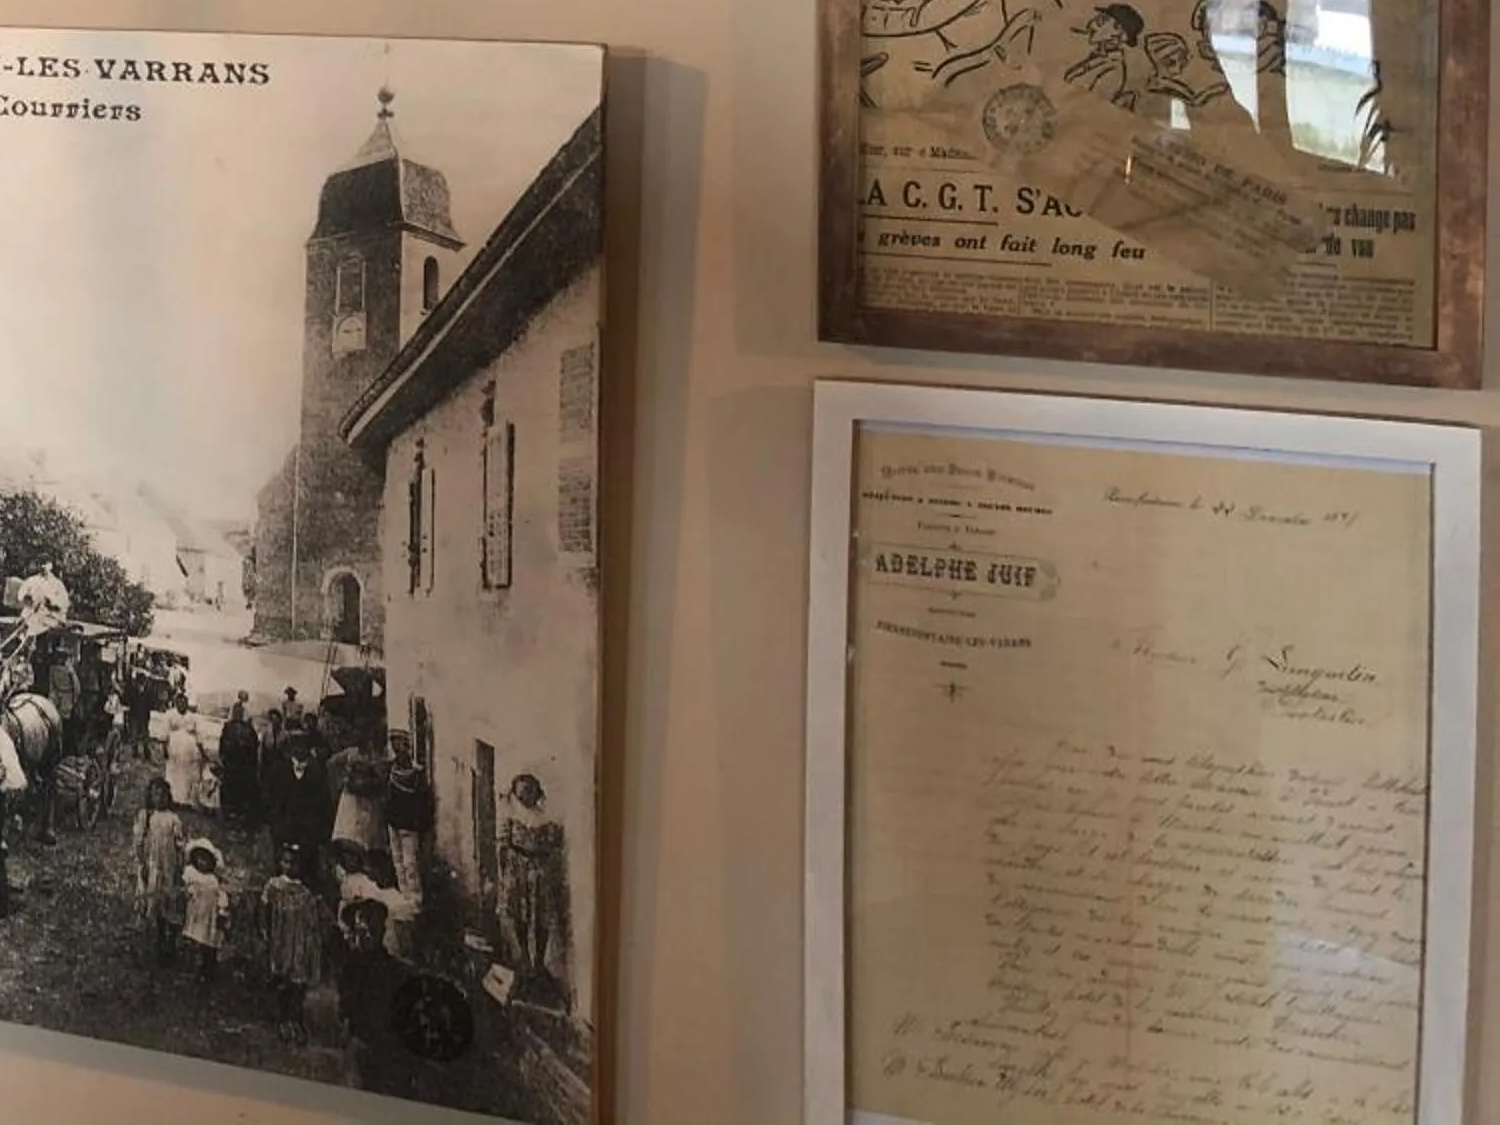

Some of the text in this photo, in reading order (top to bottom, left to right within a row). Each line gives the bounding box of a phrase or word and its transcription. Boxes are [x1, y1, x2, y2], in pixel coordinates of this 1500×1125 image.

[878, 229, 1146, 260] grèves ont fait long feu
[874, 552, 979, 582] ADELPHE
